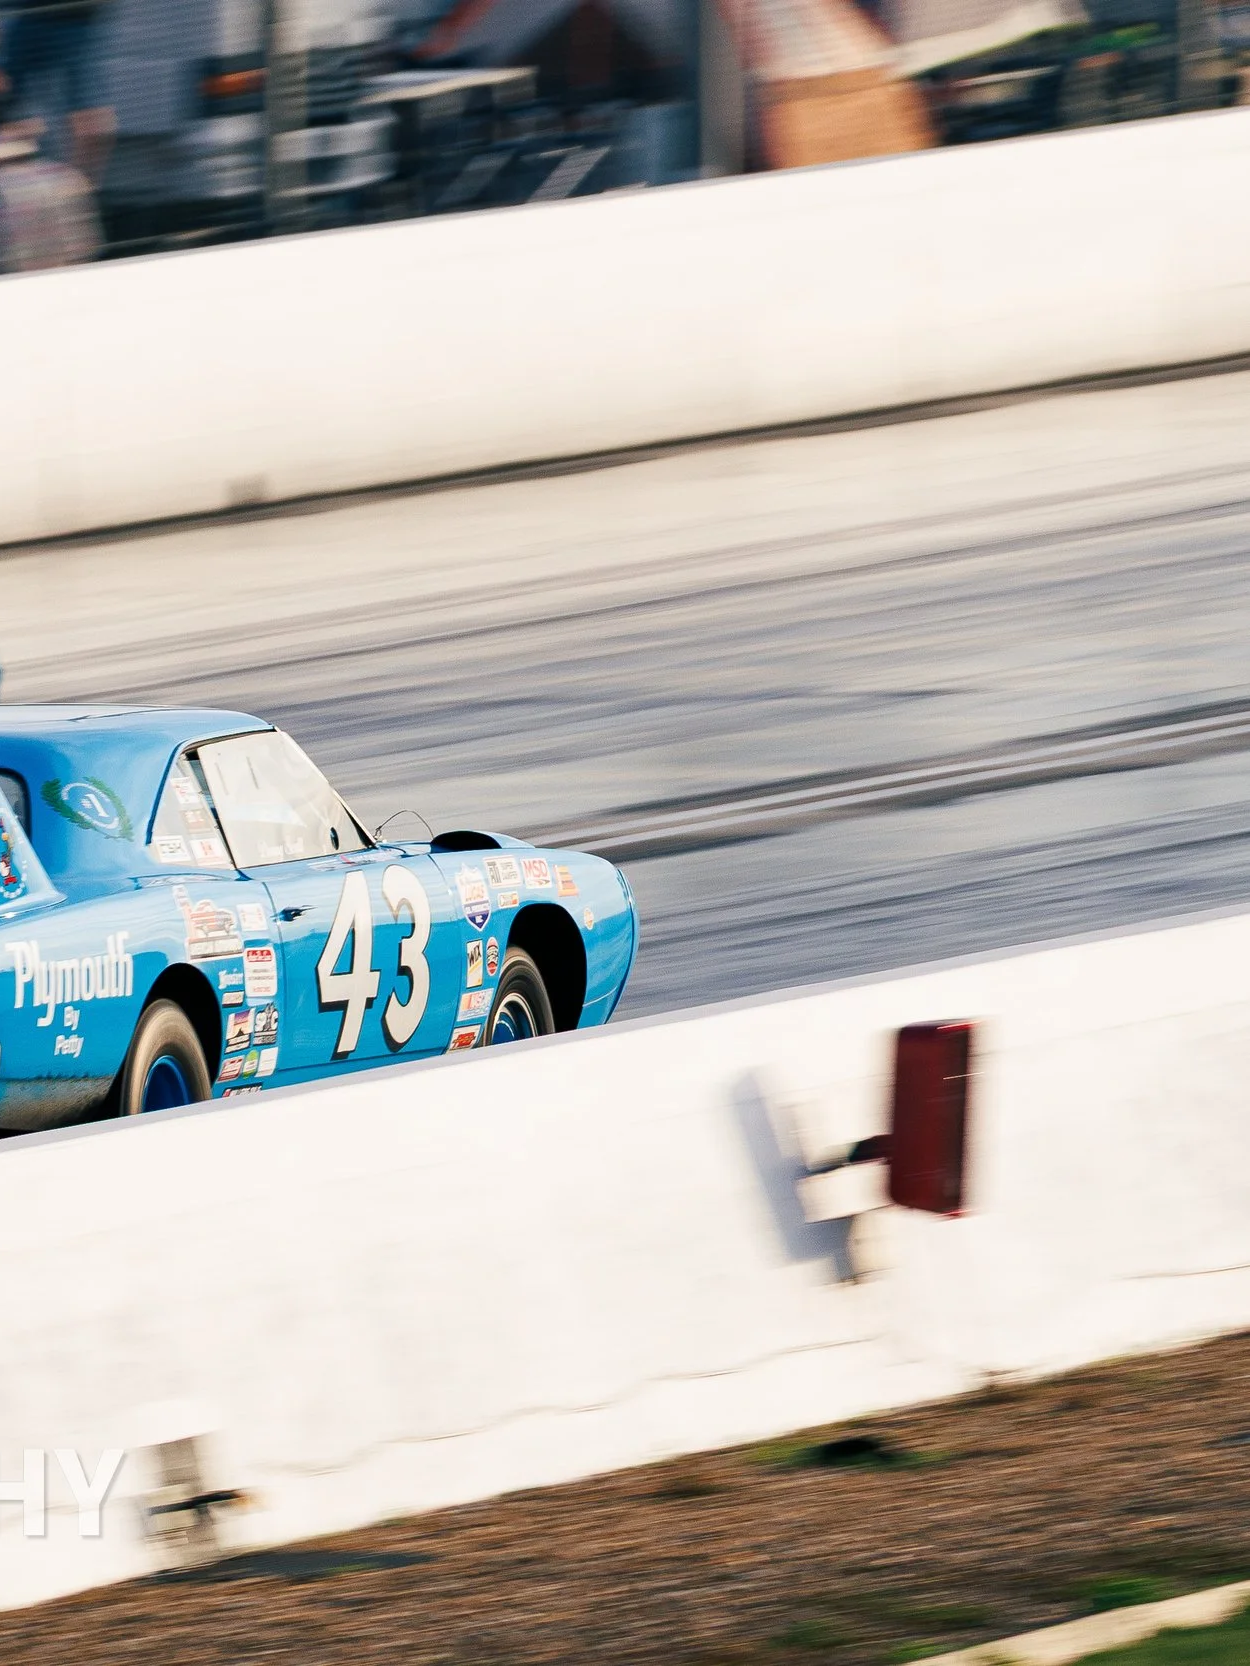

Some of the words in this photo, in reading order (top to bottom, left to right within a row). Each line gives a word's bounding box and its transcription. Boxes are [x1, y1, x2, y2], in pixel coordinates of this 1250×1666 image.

[523, 860, 549, 878] MSD
[316, 864, 432, 1057] 43
[5, 931, 134, 1028] Plymouth
[63, 1005, 81, 1031] By
[53, 1034, 85, 1059] Petty
